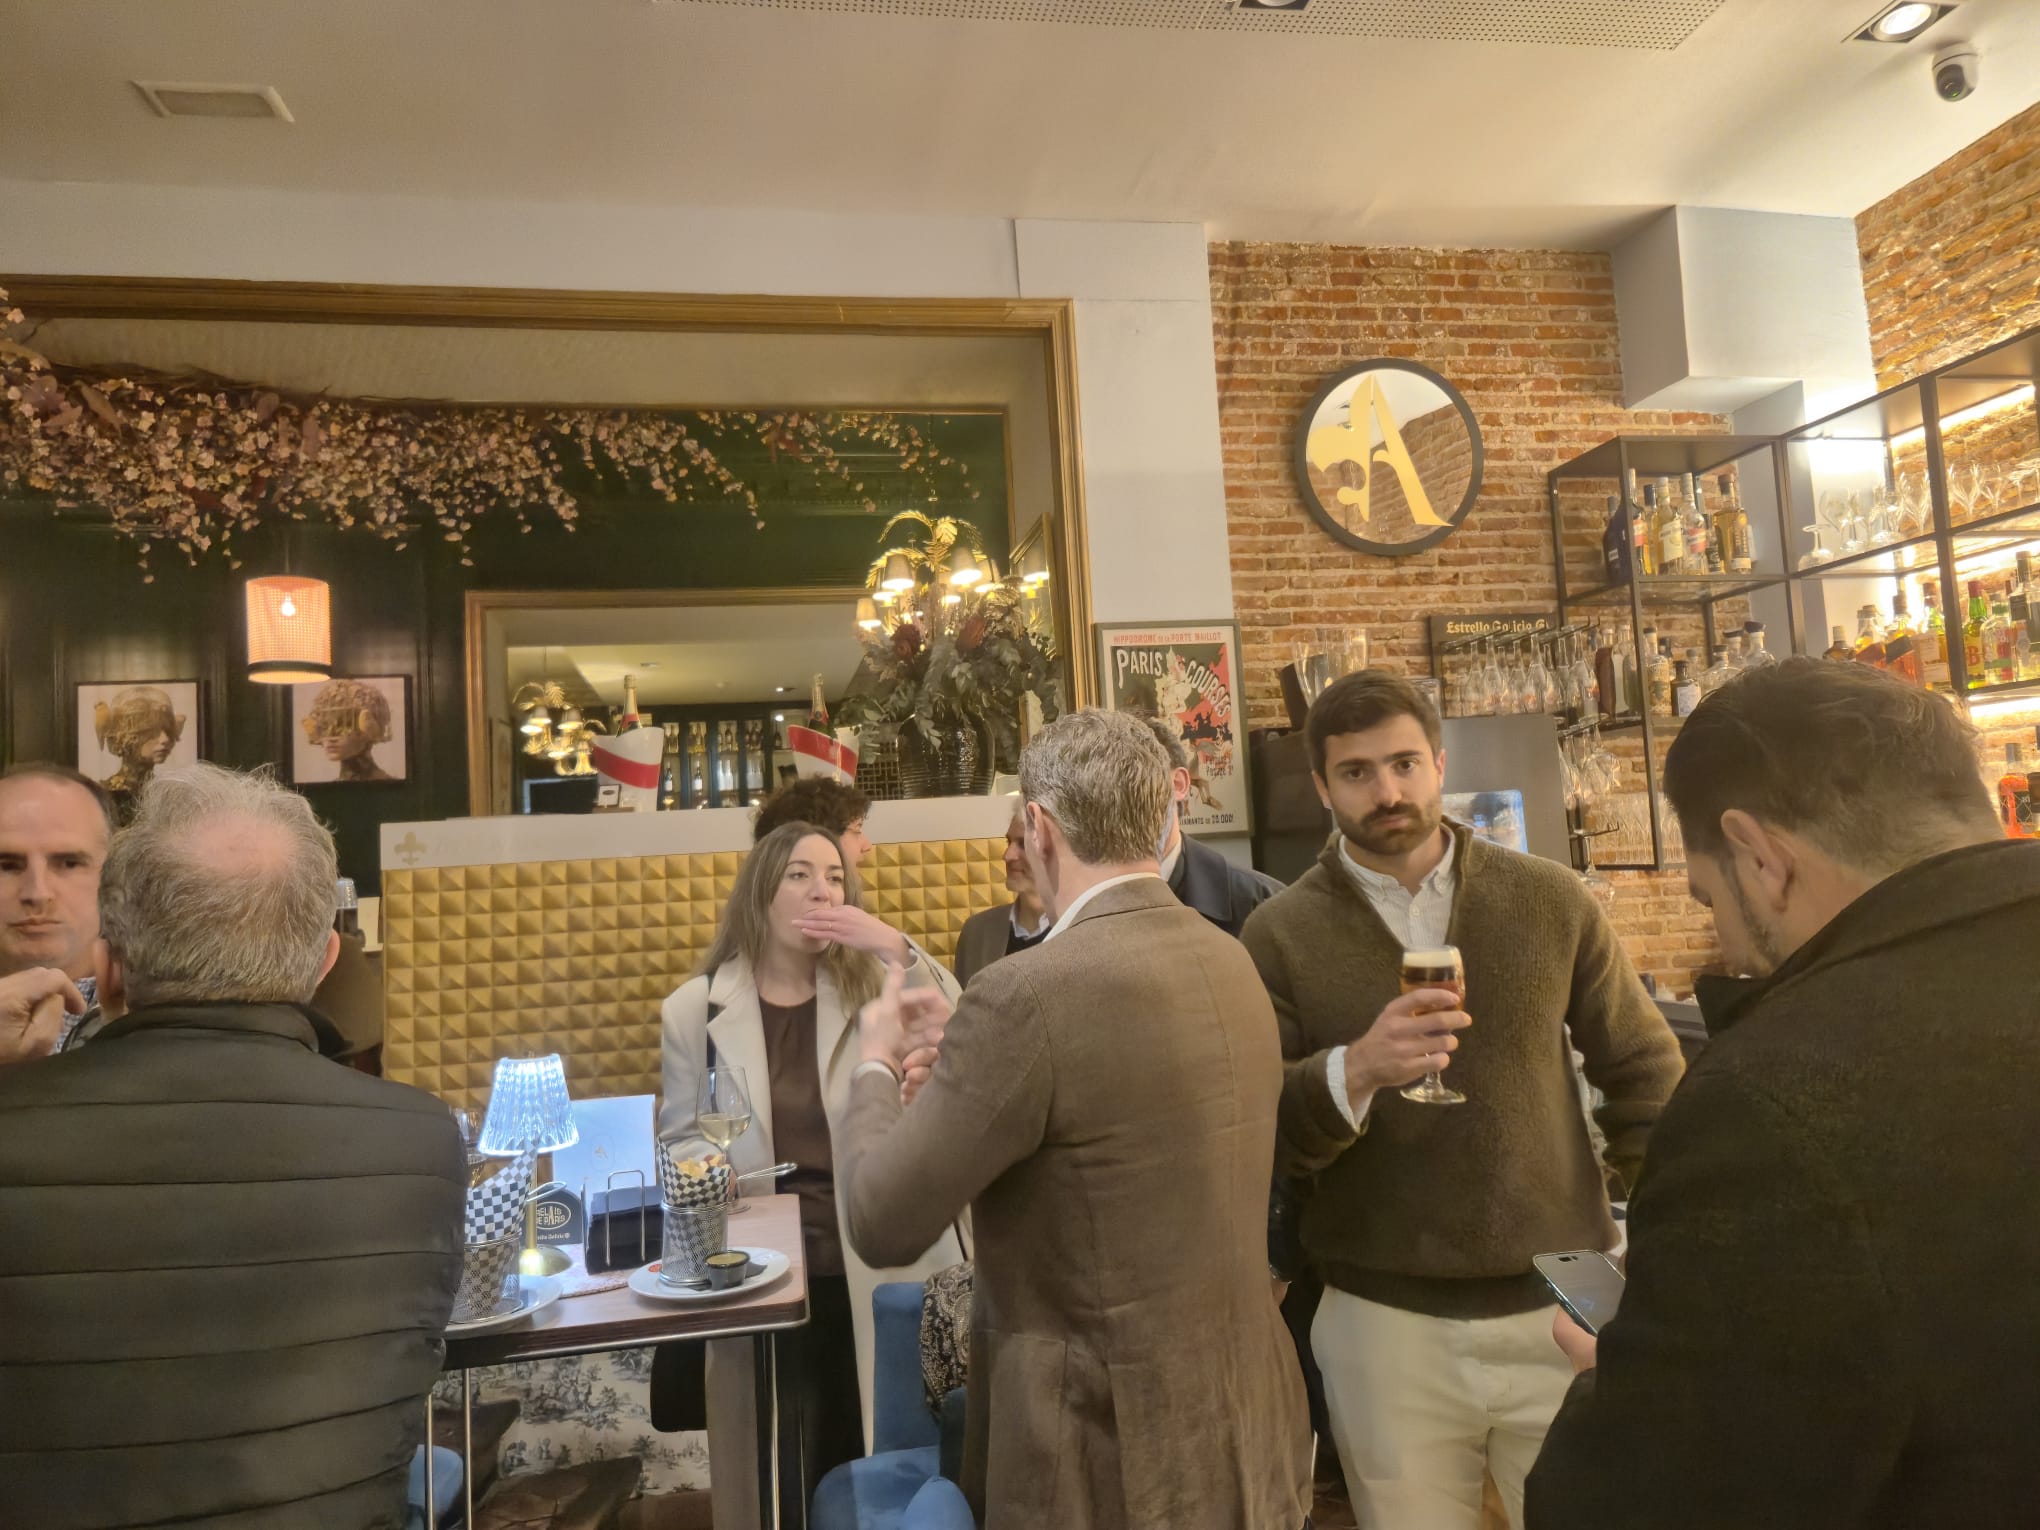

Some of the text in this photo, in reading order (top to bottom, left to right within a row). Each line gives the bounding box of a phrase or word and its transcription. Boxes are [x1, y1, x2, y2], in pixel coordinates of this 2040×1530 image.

[1113, 634, 1157, 644] HIPPODROME
[1171, 633, 1192, 641] PORTE
[1194, 632, 1221, 640] MAILLOT
[1492, 619, 1532, 633] Gaicia
[1116, 649, 1163, 689] PARIS
[1185, 660, 1231, 718] COURSES
